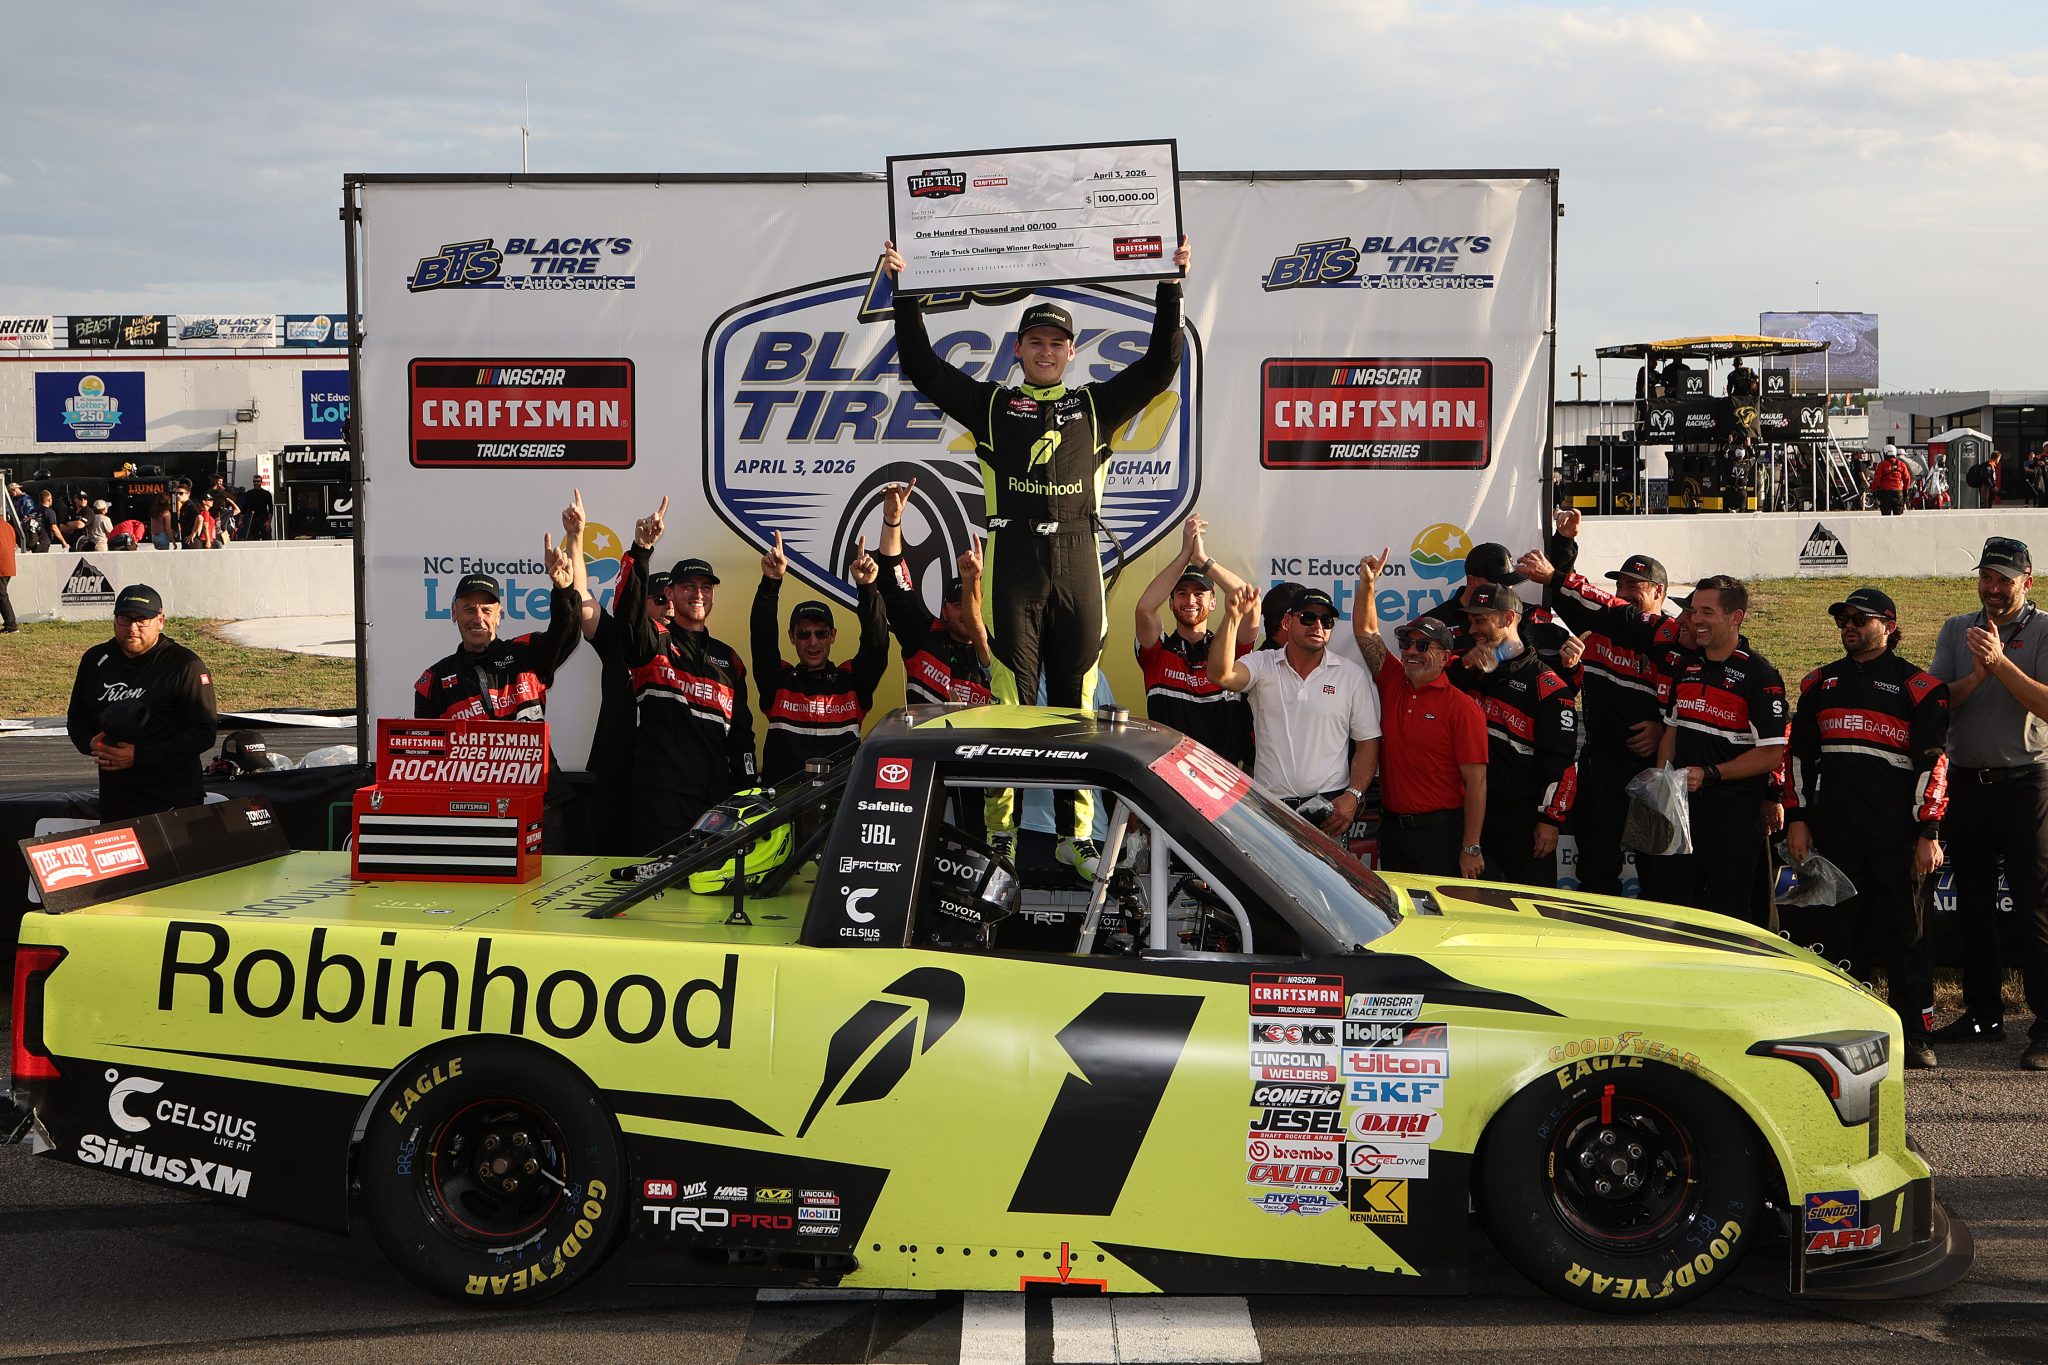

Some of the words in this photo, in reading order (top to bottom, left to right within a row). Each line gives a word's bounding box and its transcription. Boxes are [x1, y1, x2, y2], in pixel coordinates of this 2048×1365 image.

[911, 176, 934, 190] THE
[935, 174, 964, 188] TRIP
[1093, 172, 1113, 180] April
[1115, 171, 1123, 179] 3,
[1086, 196, 1092, 204] $
[1098, 192, 1155, 203] 100,000.00
[934, 228, 968, 238] Hundred
[970, 226, 1008, 235] Thousand
[1010, 224, 1025, 232] and
[1027, 222, 1057, 231] 00/100
[504, 237, 633, 255] BLACK'S
[930, 250, 950, 258] Triple
[952, 248, 970, 256] Truck
[972, 246, 1005, 256] Challenge
[1006, 244, 1030, 252] Winner
[1032, 242, 1074, 250] Rockingham
[1116, 244, 1160, 252] CRAFTSMAN
[1361, 236, 1491, 254] BLACK'S
[530, 257, 600, 274] TIRE
[1387, 255, 1458, 273] TIRE
[503, 276, 516, 290] &
[1360, 275, 1373, 290] &
[75, 316, 117, 338] BEAST
[219, 318, 272, 326] BLACK'S
[123, 320, 160, 341] BEAST
[289, 330, 326, 338] Lottery
[498, 368, 566, 386] NASCAR
[1352, 368, 1422, 386] NASCAR
[310, 393, 326, 402] NC
[80, 411, 104, 422] 250
[422, 400, 619, 428] CRAFTSMAN
[733, 389, 948, 445] TIRE
[1275, 400, 1476, 428] CRAFTSMAN
[1685, 420, 1710, 428] RACING
[476, 443, 519, 458] TRUCK
[519, 443, 566, 458] SERIES
[1329, 444, 1372, 459] TRUCK
[1372, 444, 1420, 459] SERIES
[734, 459, 788, 474] APRIL
[793, 459, 806, 476] 3,
[812, 459, 856, 474] 2026
[1008, 476, 1083, 496] Robinhood
[1806, 540, 1839, 556] ROCK
[424, 557, 454, 575] NC
[1271, 558, 1303, 576] NC
[68, 576, 105, 594] ROCK
[97, 682, 147, 702] Tricon
[390, 738, 444, 748] CRAFTSMAN
[450, 732, 541, 747] CRAFTSMAN
[450, 746, 487, 760] 2026
[489, 748, 543, 762] WINNER
[987, 746, 1046, 758] COREY
[1044, 750, 1089, 760] HEIM
[388, 760, 543, 785] ROCKINGHAM
[246, 808, 271, 821] TOYOTA
[452, 803, 488, 811] CRAFTSMAN
[858, 800, 914, 814] Safelite
[861, 824, 896, 846] JBL
[32, 849, 60, 876] THE
[57, 843, 90, 867] TRIP
[97, 847, 140, 868] CRAFTSMAN
[940, 900, 982, 921] TOYOTA
[840, 927, 881, 938] CELSIUS
[158, 920, 740, 1050] Robinhood
[1287, 976, 1317, 984] NASCAR
[1254, 988, 1339, 1002] CRAFTSMAN
[1372, 997, 1413, 1008] NASCAR
[1278, 1006, 1296, 1014] TRUCK
[1296, 1006, 1316, 1014] SERIES
[1352, 1008, 1377, 1016] RACE
[1381, 1008, 1414, 1017] TRUCK
[1251, 1024, 1336, 1047] KOOKS
[1345, 1023, 1404, 1046] Holley
[1548, 1032, 1700, 1070] GOODYEAR
[1254, 1054, 1323, 1068] LINCOLN
[1349, 1053, 1441, 1075] tilton
[1269, 1068, 1329, 1081] WELDERS
[1556, 1055, 1645, 1090] EAGLE
[389, 1057, 464, 1125] EAGLE
[1254, 1086, 1342, 1105] COMETIC
[1350, 1081, 1440, 1103] SKF
[156, 1100, 257, 1142] CELSIUS
[1250, 1109, 1346, 1134] JESEL
[1260, 1132, 1283, 1140] SHAFT
[213, 1136, 235, 1149] LIVE
[236, 1141, 252, 1153] FIT
[1273, 1144, 1334, 1161] brembo
[77, 1133, 252, 1199] SiriusXM
[1248, 1164, 1344, 1185] CALICO
[648, 1183, 674, 1196] SEM
[683, 1180, 708, 1196] WIX
[714, 1186, 748, 1197] HMS
[801, 1190, 833, 1198] LINCOLN
[1265, 1194, 1298, 1205] FIVE
[1299, 1195, 1328, 1206] STAR
[642, 1206, 730, 1232] TRD
[730, 1214, 793, 1230] PRO
[800, 1208, 828, 1220] Mobil
[829, 1208, 840, 1220] 1
[1350, 1213, 1406, 1224] KENNAMETAL
[1808, 1204, 1858, 1220] SUNOCO
[464, 1179, 607, 1296] GOODYEAR
[799, 1224, 839, 1235] COMETIC
[1809, 1224, 1882, 1250] ARP
[1564, 1220, 1742, 1299] GOODYEAR
